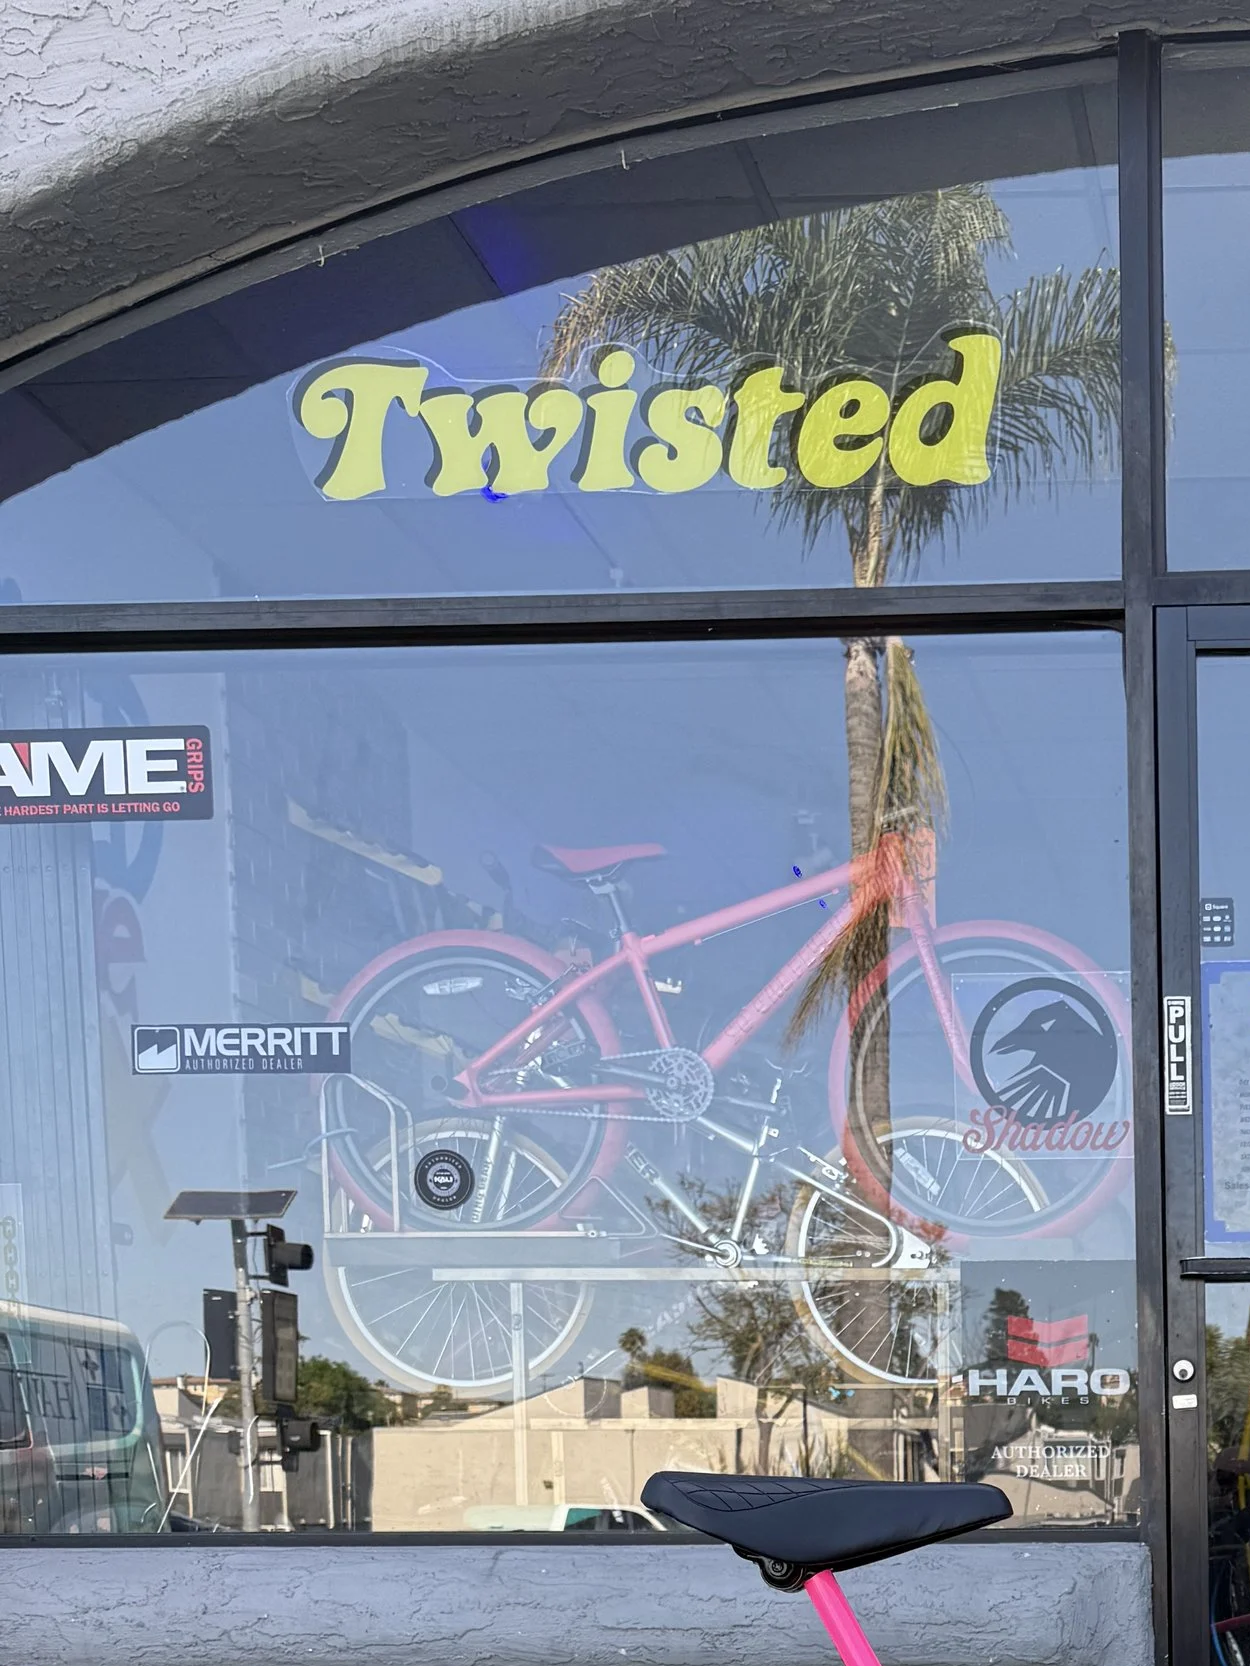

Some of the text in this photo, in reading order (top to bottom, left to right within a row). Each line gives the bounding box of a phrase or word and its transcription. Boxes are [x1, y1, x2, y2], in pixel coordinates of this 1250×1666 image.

[297, 330, 1001, 500] Twisted
[186, 738, 204, 793] GRIPS
[4, 801, 181, 816] HARDEST PART IS LETTING GO
[183, 1027, 348, 1057] MERRITT
[1168, 1006, 1185, 1081] PULL
[185, 1057, 303, 1070] AUTHORIZED DEALER
[963, 1105, 1130, 1153] Shadow
[968, 1369, 1130, 1396] HARO
[1007, 1397, 1089, 1405] BIKES
[991, 1446, 1111, 1460] AUTHORIZED
[1016, 1463, 1087, 1478] DEALER
